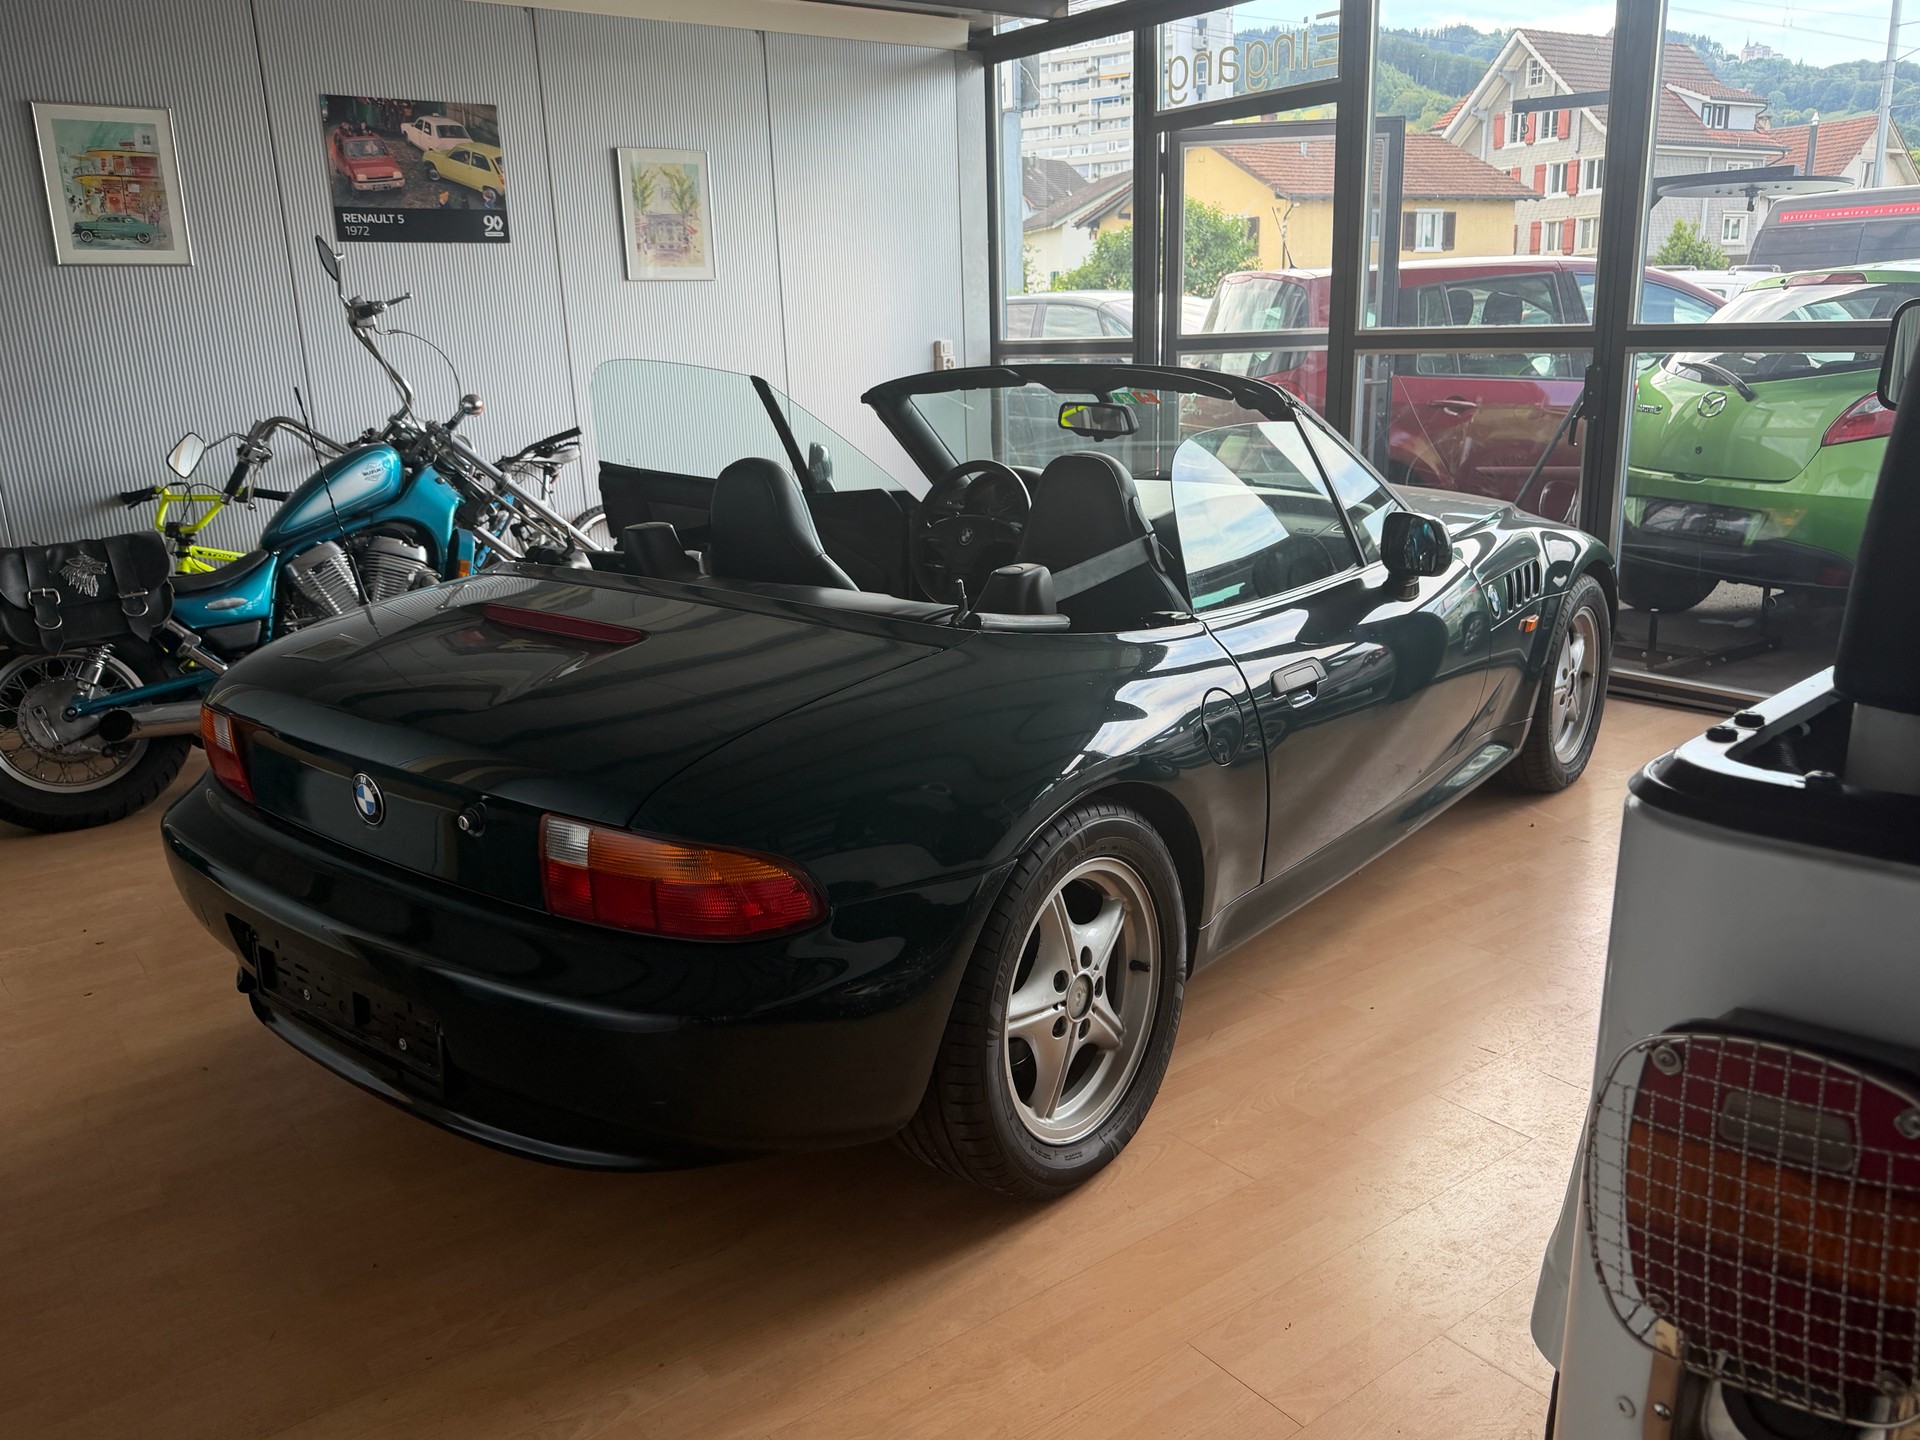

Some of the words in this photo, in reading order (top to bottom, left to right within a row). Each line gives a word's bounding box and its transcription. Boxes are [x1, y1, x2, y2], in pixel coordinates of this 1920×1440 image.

[342, 212, 395, 224] RENAULT
[397, 214, 405, 224] 5
[483, 214, 504, 231] 90
[345, 225, 370, 236] 1972
